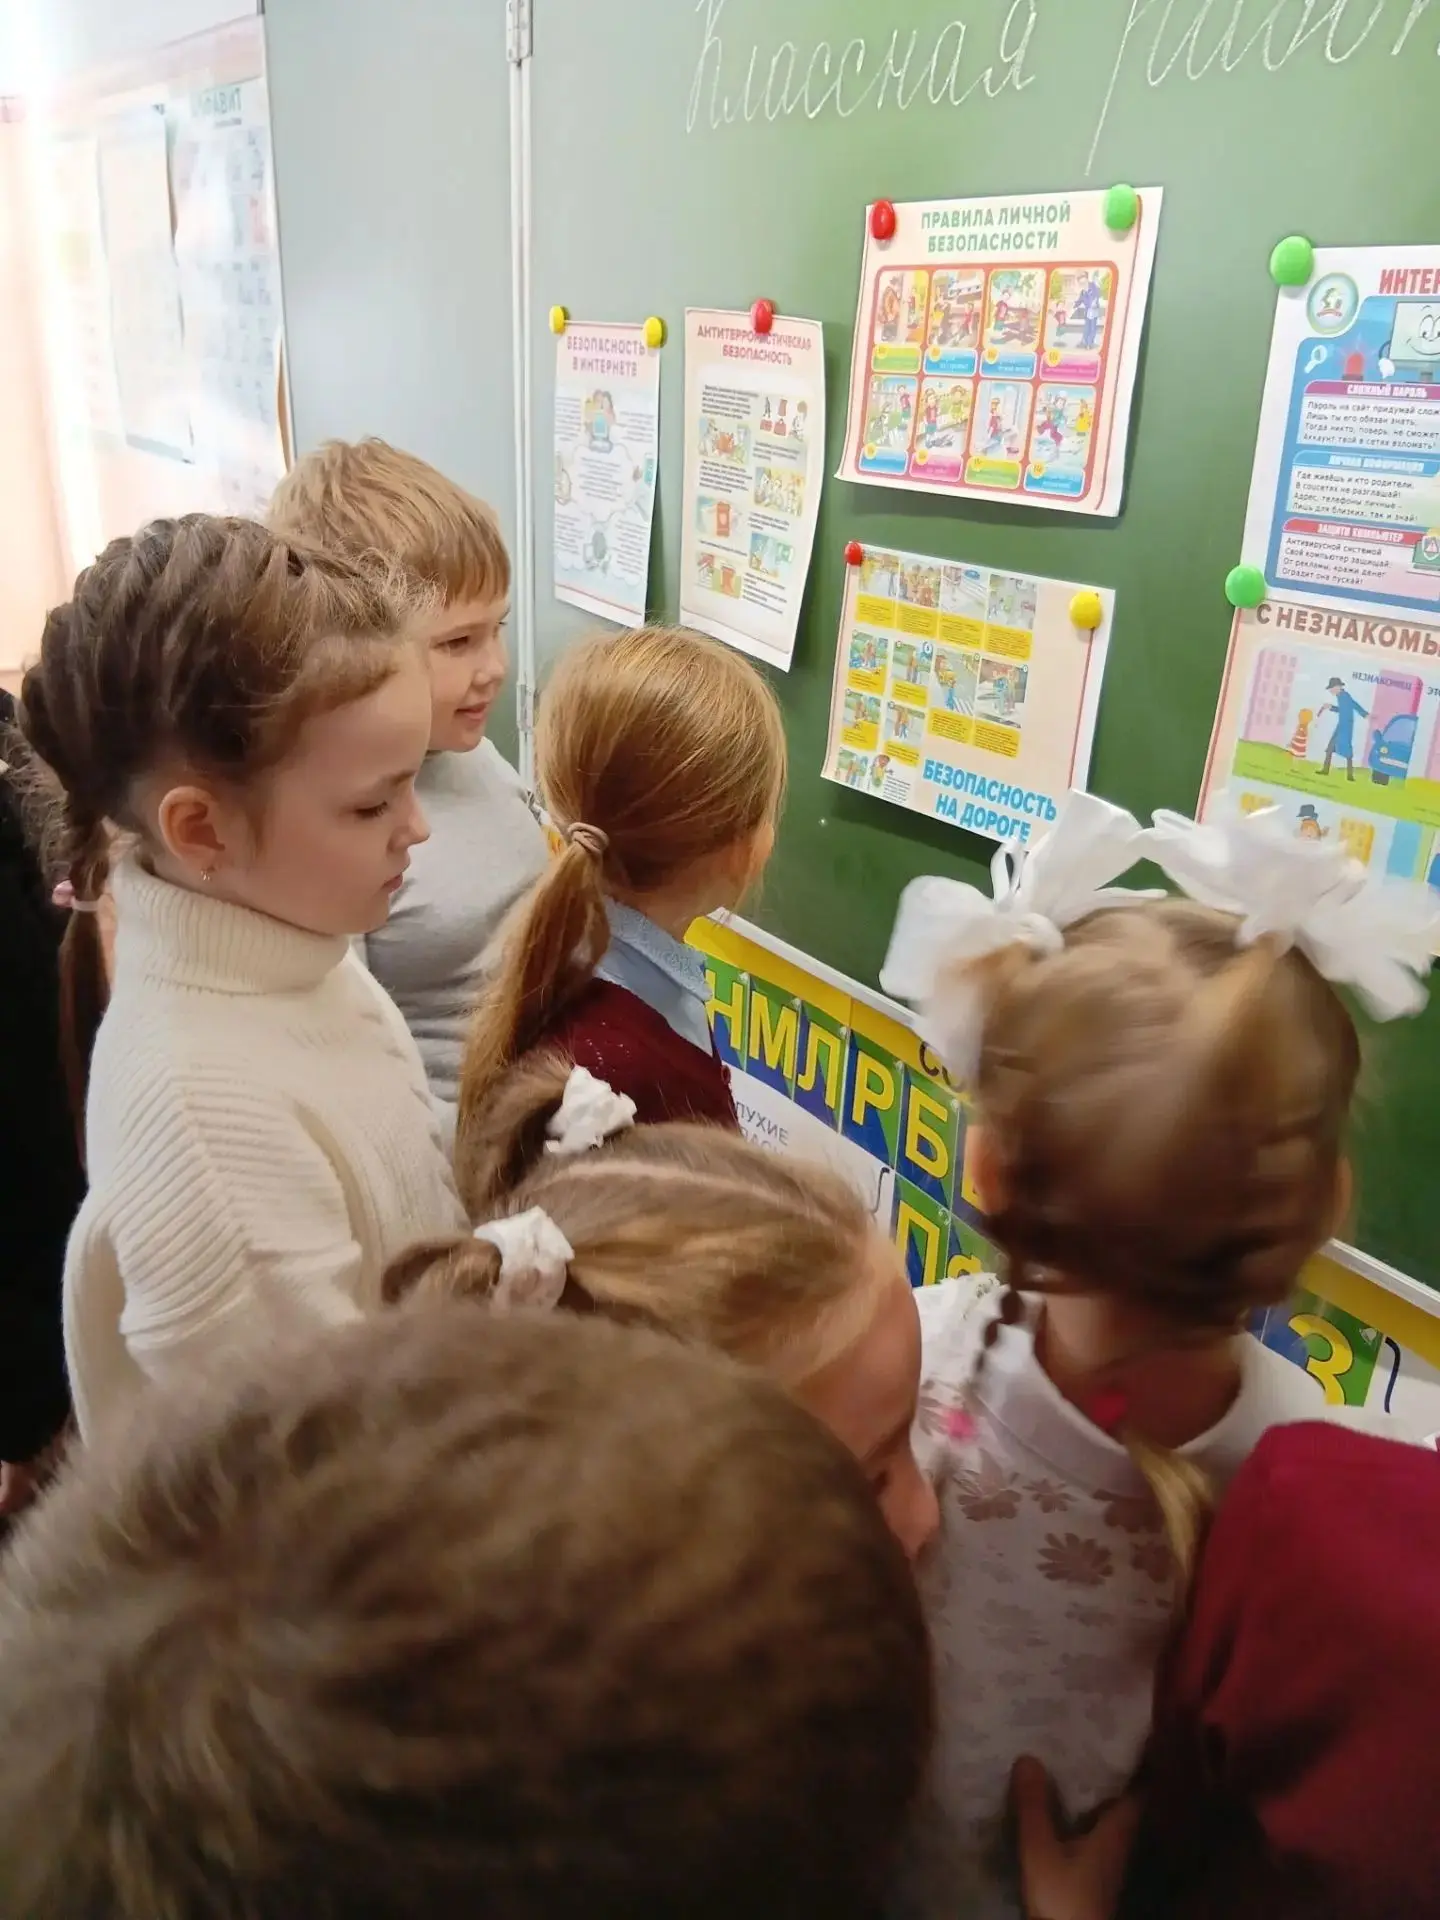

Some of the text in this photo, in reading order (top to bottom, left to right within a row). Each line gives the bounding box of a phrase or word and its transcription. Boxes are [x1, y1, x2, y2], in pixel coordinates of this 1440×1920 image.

[921, 201, 1071, 230] ПРАВИЛА ЛИЧНОЙ
[927, 231, 1059, 253] БЕЗОПАСНОСТИ
[567, 335, 646, 356] БЕЗОПАСНОСТЬ
[722, 344, 792, 366] БЕЗОПАСНОСТЬ
[572, 356, 637, 377] В ИНТЕРНЕТЕ
[1306, 411, 1329, 420] Лишь
[1307, 401, 1337, 411] Пароль
[1373, 405, 1415, 415] придумай
[1305, 422, 1328, 431] Тогда
[1338, 435, 1357, 443] твой
[1366, 438, 1389, 446] сетях
[1296, 470, 1311, 480] Где
[1313, 474, 1345, 483] живёшь
[1355, 477, 1369, 485] кто
[1303, 484, 1338, 493] соцсетях
[1321, 495, 1362, 505] телефоны
[1292, 502, 1313, 511] Лишь
[1314, 505, 1330, 513] для
[1370, 511, 1383, 519] так
[1285, 547, 1304, 556] Свой
[1305, 551, 1349, 563] компьютер
[1286, 537, 1382, 556] Антивирусной системой
[1282, 567, 1314, 578] Оградит
[1283, 557, 1293, 565] От
[1333, 565, 1360, 575] кражи
[1361, 568, 1387, 578] денег
[1256, 603, 1272, 625] С
[922, 758, 1057, 822] БЕЗОПАСНОСТЬ
[935, 793, 1032, 844] НА ДОРОГЕ
